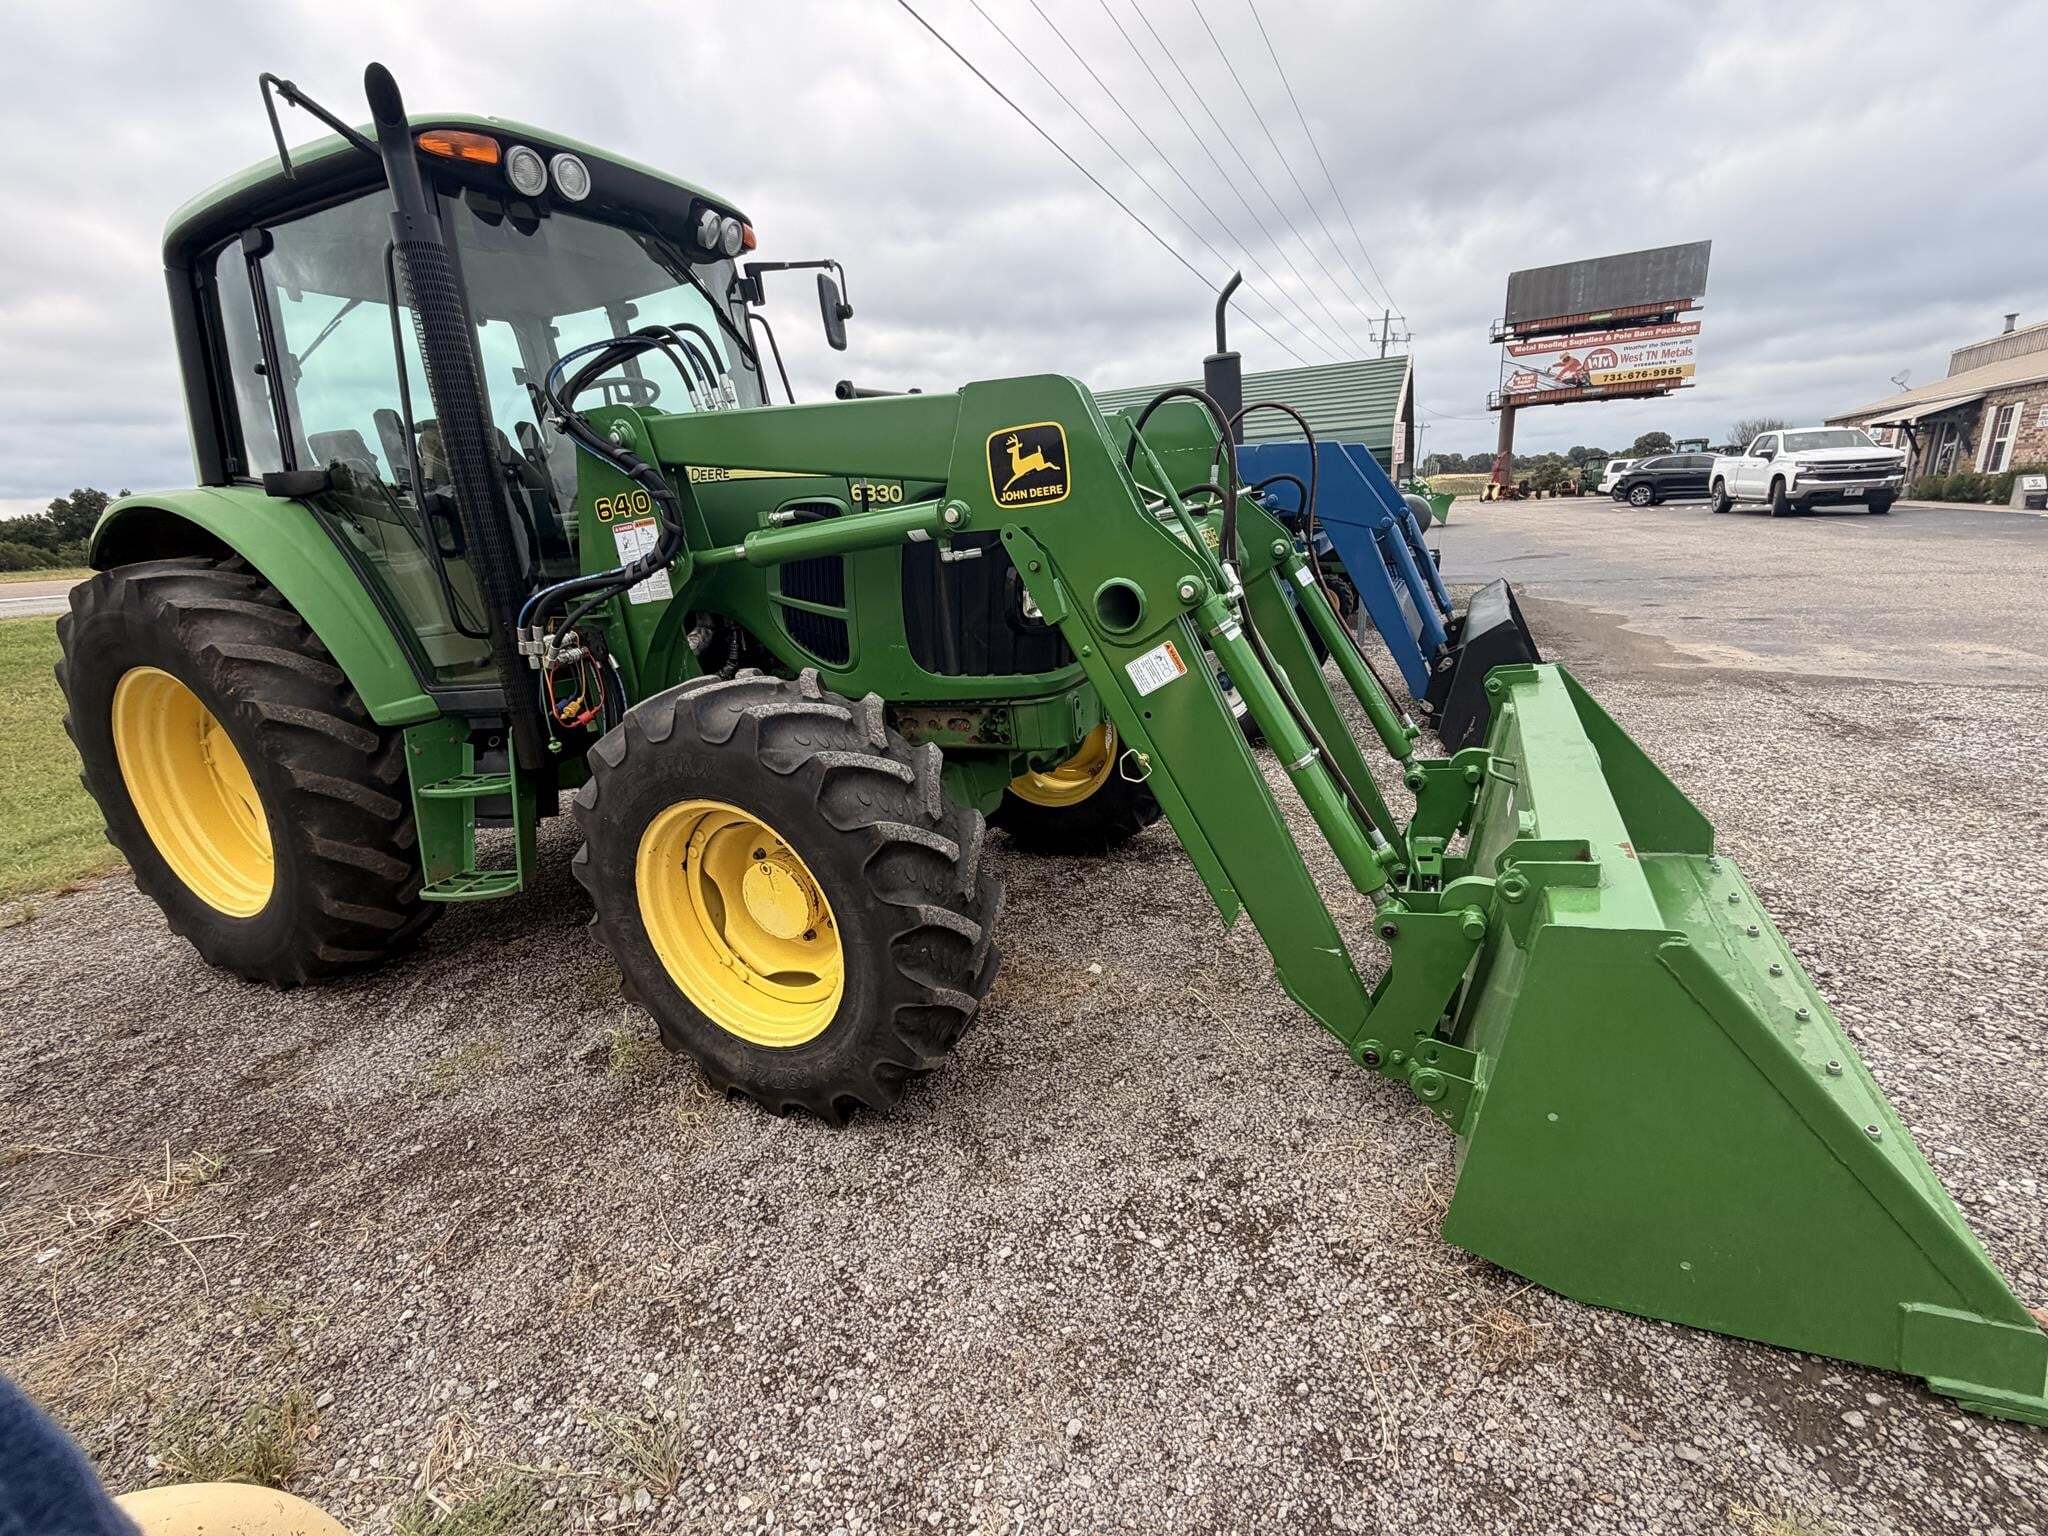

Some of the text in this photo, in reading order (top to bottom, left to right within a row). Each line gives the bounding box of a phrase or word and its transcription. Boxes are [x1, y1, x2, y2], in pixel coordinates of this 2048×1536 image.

[1515, 344, 1536, 353] Metal
[1538, 340, 1568, 350] Roofing
[1569, 336, 1604, 346] Supplies
[1613, 332, 1632, 340] Pole
[1634, 329, 1654, 338] Barn
[1655, 324, 1697, 335] Packages
[1620, 346, 1693, 363] West TN Metals
[691, 467, 730, 482] DEERE
[851, 484, 903, 503] 6330
[1000, 484, 1064, 502] JOHN DEERE
[595, 489, 652, 522] 640
